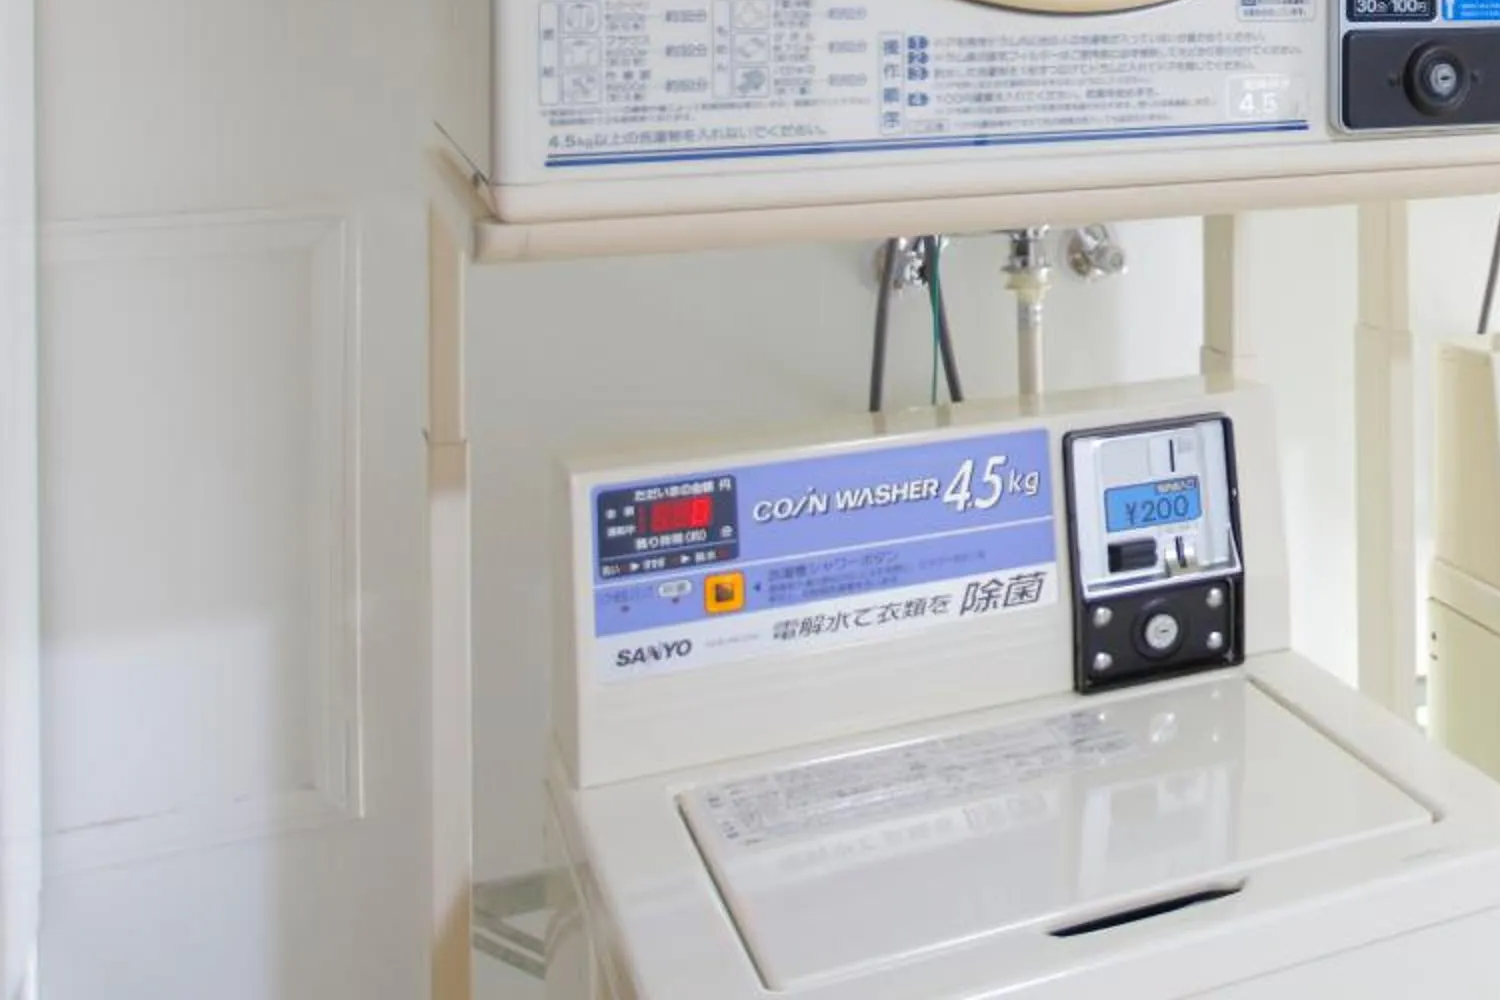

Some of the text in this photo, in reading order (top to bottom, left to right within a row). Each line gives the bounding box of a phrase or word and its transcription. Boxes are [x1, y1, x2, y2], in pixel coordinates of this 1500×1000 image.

[835, 478, 940, 512] WASHER
[1125, 494, 1190, 526] ¥200
[772, 570, 1047, 641] 電解水で衣類を 除菌
[615, 638, 693, 668] SANYO
